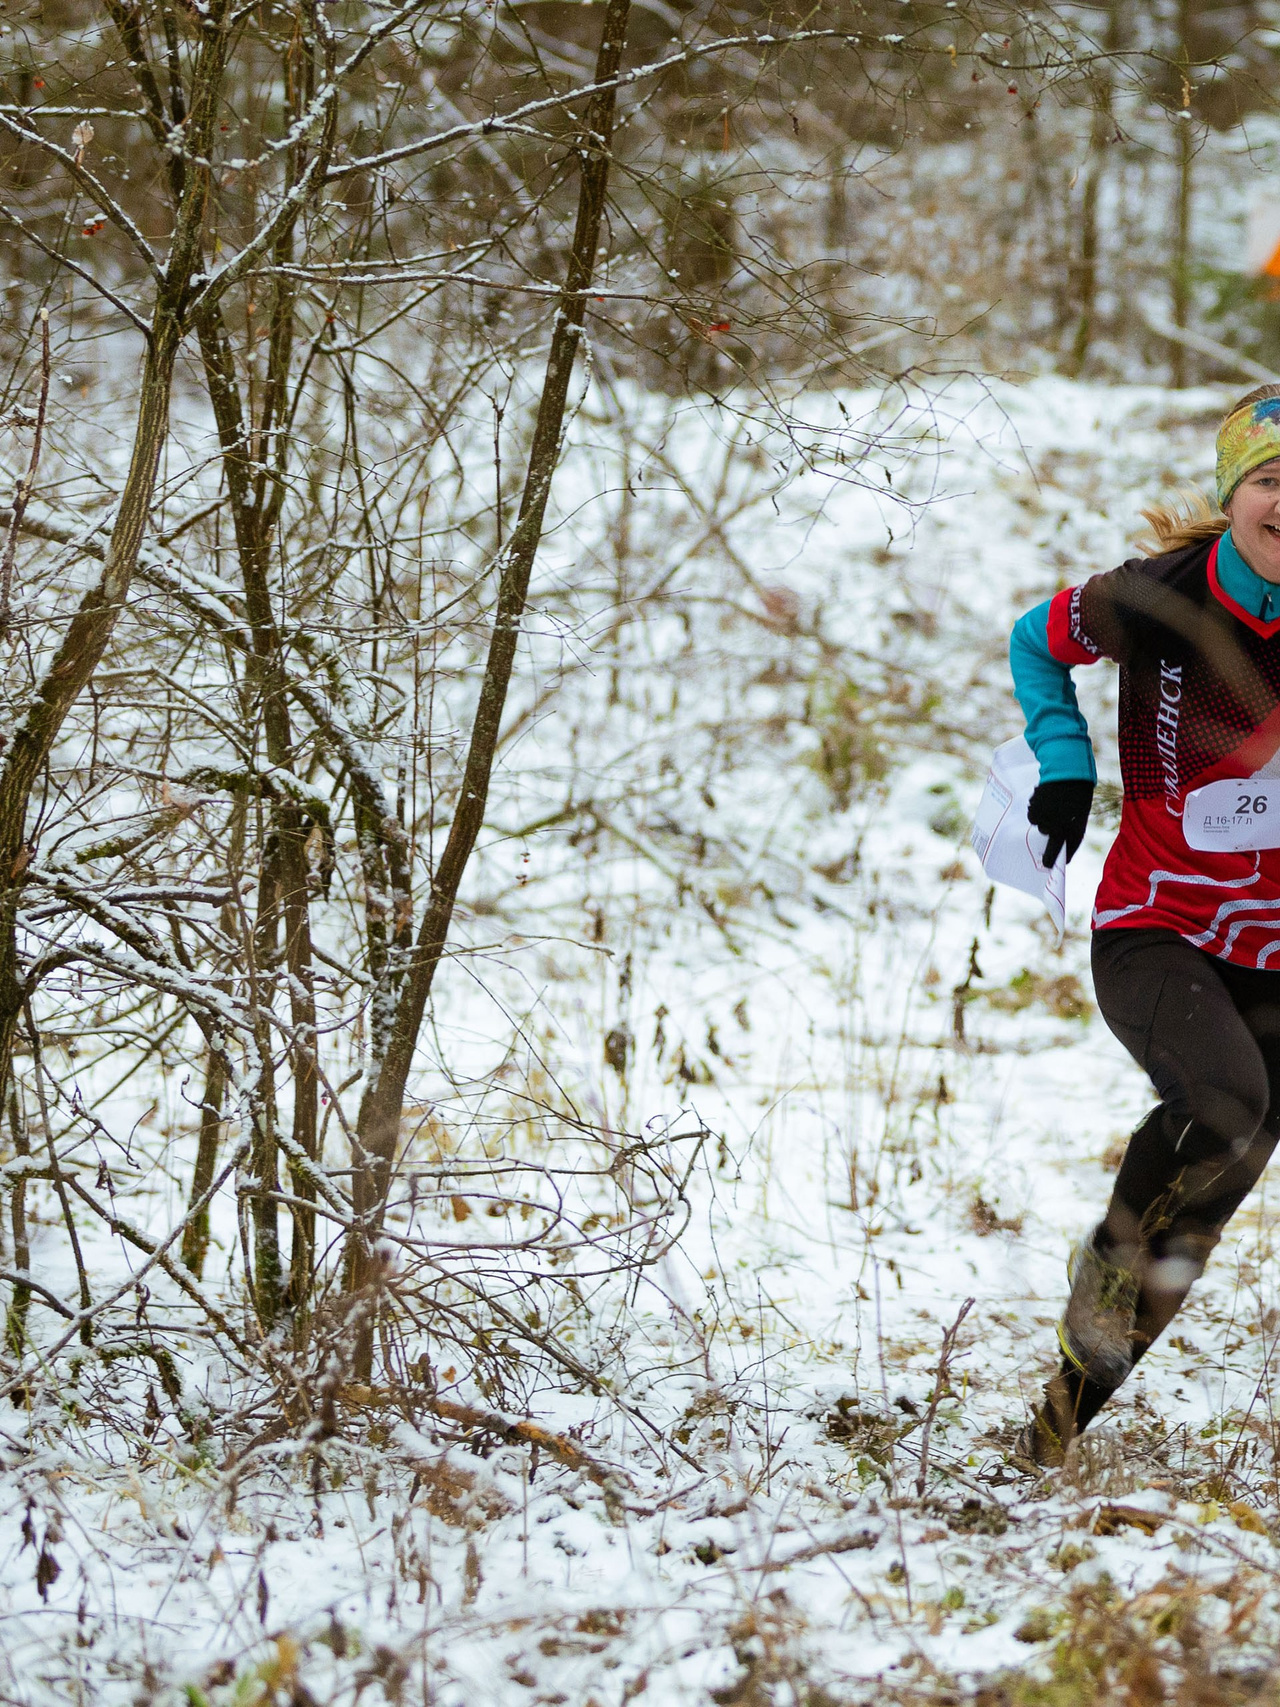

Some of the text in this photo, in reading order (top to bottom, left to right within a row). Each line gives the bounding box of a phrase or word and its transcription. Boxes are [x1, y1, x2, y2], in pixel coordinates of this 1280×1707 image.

[1235, 795, 1268, 814] 26
[1203, 815, 1212, 826] Д
[1216, 815, 1243, 825] 16-17
